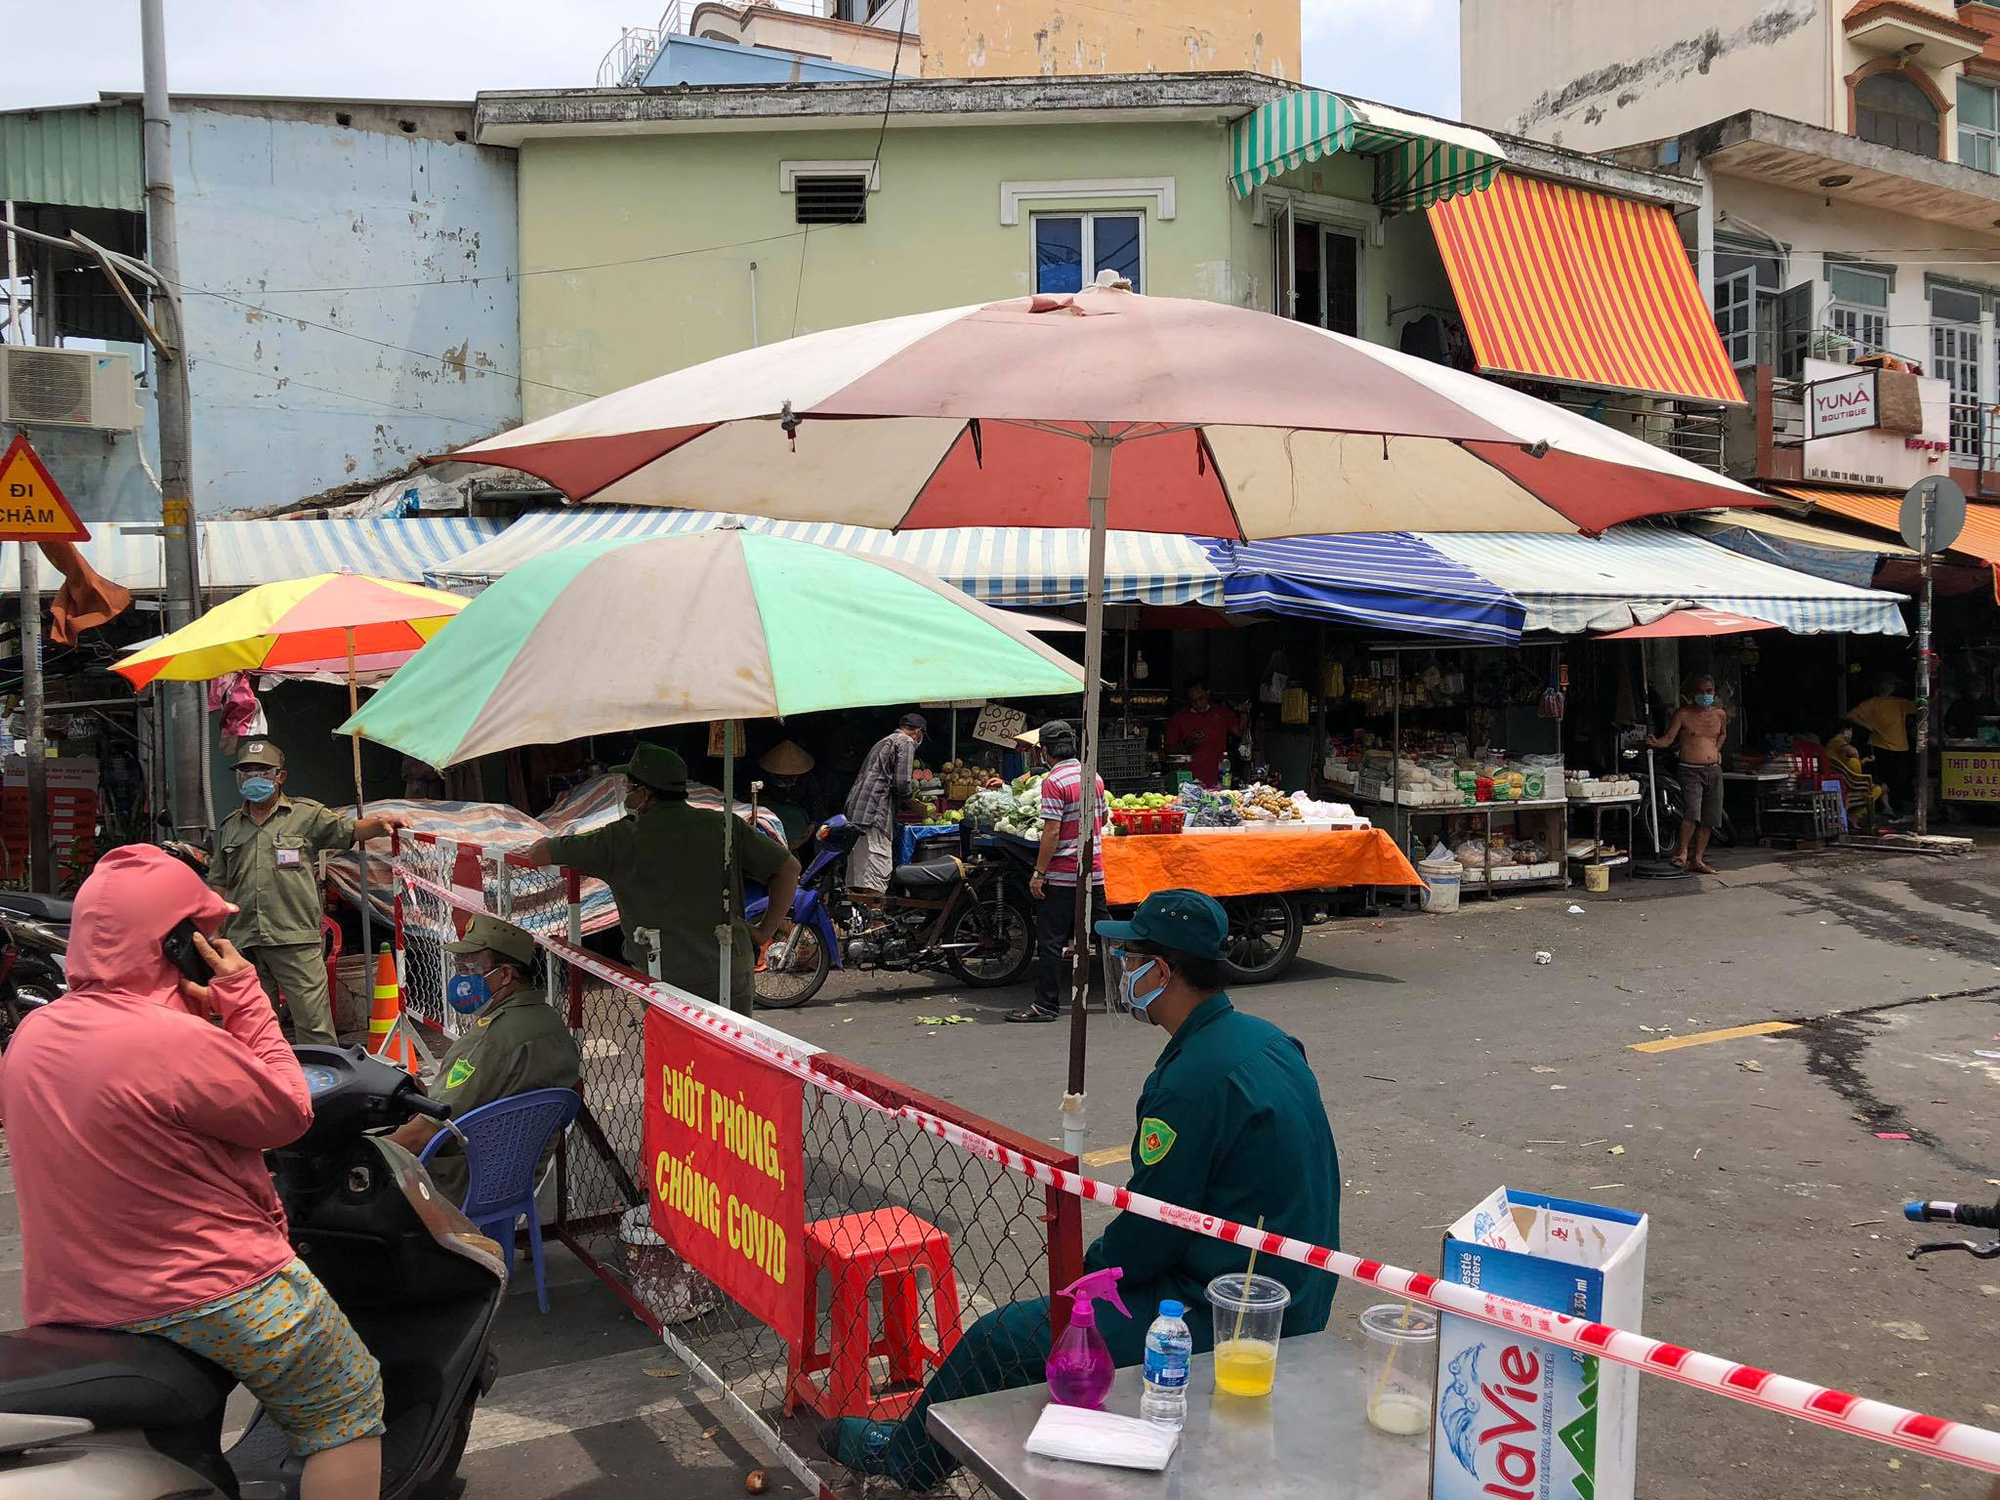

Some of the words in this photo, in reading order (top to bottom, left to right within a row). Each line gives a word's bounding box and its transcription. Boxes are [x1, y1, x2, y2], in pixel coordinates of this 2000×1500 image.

[1816, 388, 1870, 411] YUNA
[1821, 408, 1867, 422] BOUTIQUE
[9, 484, 33, 497] ĐI
[1947, 758, 1969, 771] THỊT
[1976, 775, 1983, 784] &
[662, 1060, 705, 1134] CHỐT
[710, 1090, 785, 1191] PHÒNG,
[655, 1150, 721, 1239] CHỐNG
[727, 1194, 786, 1285] COVID
[1460, 1252, 1472, 1288] estlé
[1574, 1278, 1587, 1292] ml
[1574, 1292, 1587, 1311] 350
[1543, 1352, 1555, 1390] WATER
[1542, 1391, 1553, 1436] MINERAL
